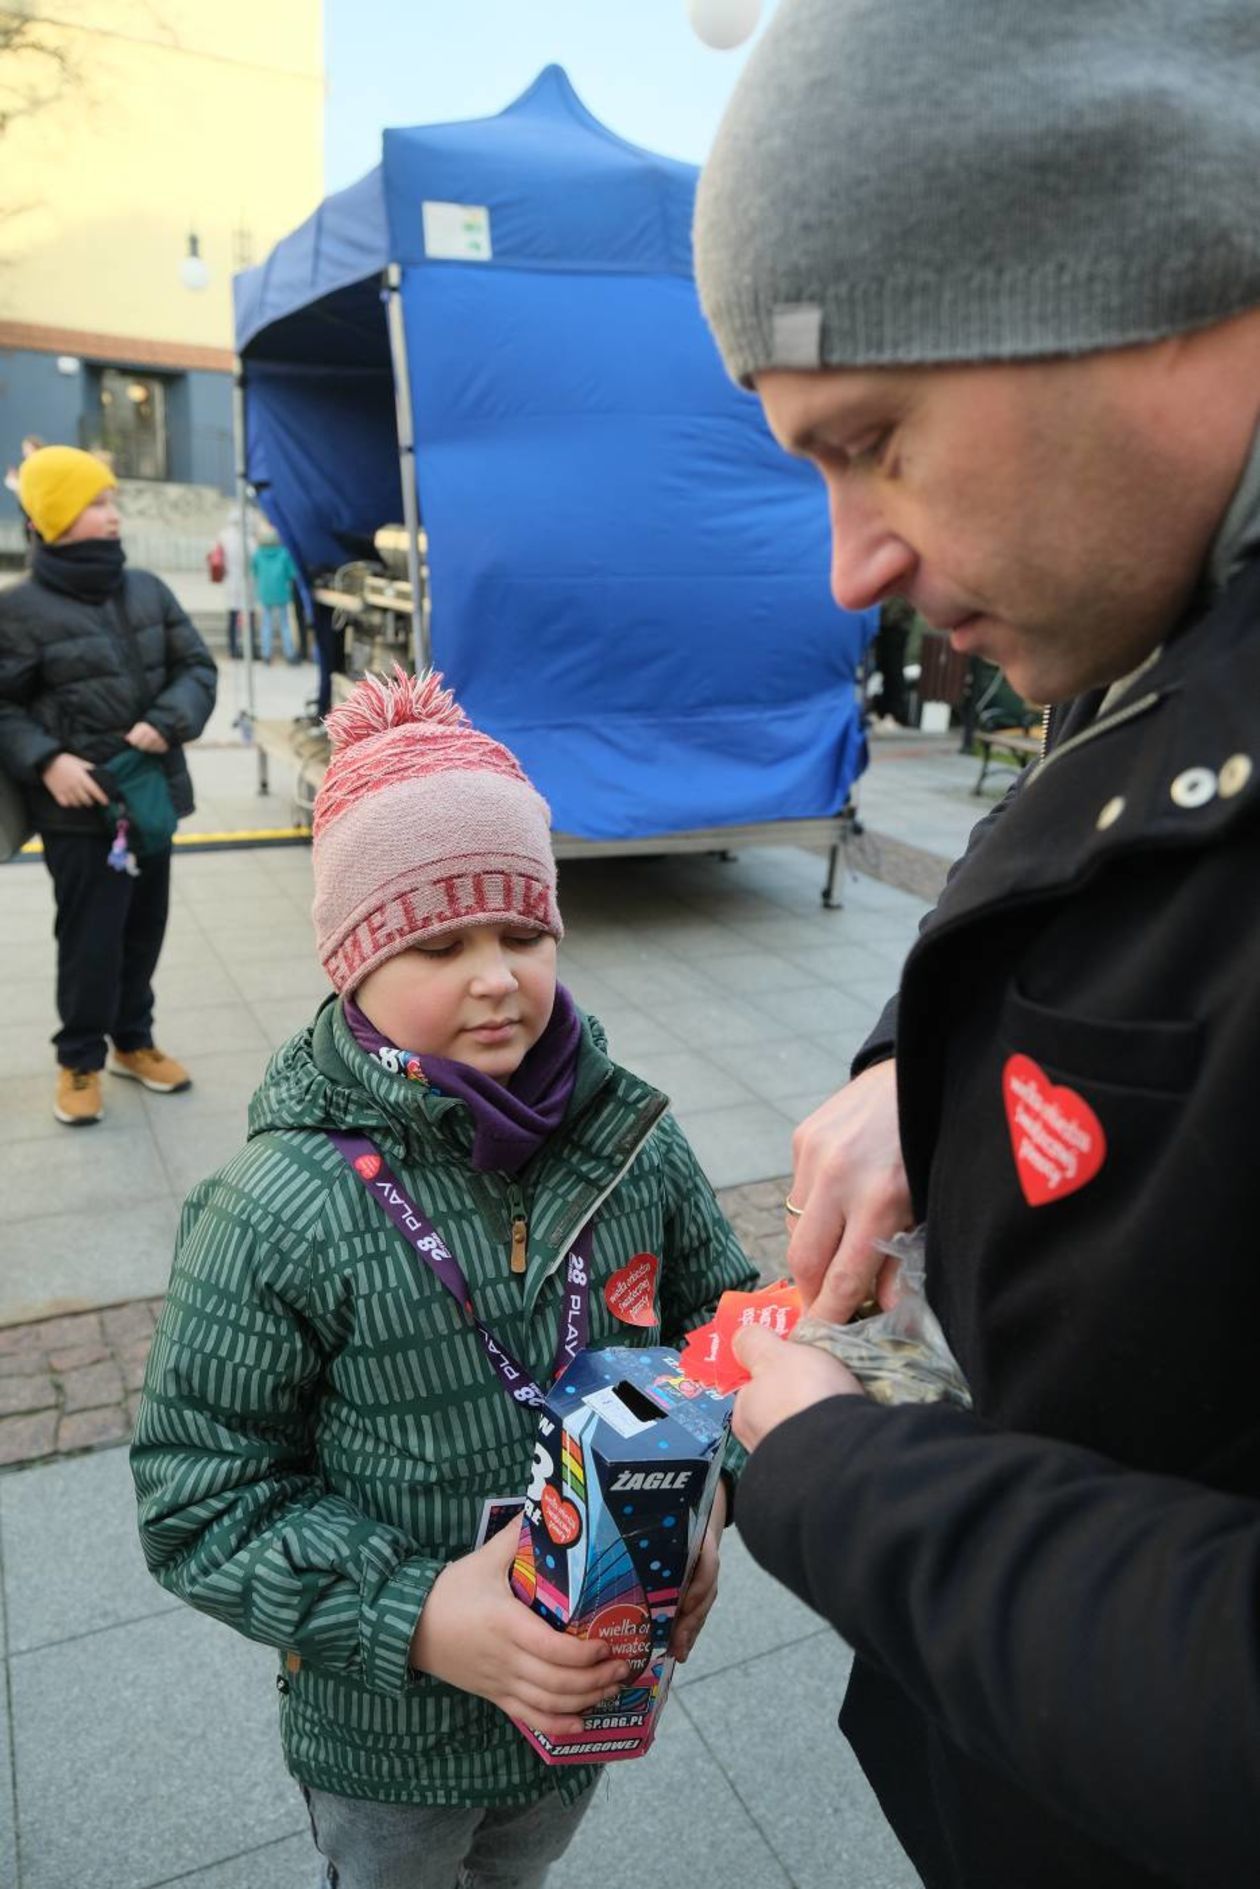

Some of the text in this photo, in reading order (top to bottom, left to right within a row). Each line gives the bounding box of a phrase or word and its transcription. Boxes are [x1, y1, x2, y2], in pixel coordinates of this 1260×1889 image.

[376, 1182, 422, 1231] PLAY
[417, 1236, 451, 1261] 28
[565, 1253, 588, 1358] 28 PLAY
[609, 1469, 692, 1492] ŻAGLE
[598, 1618, 637, 1638] wielka
[584, 1715, 643, 1730] SP.ORG.PL
